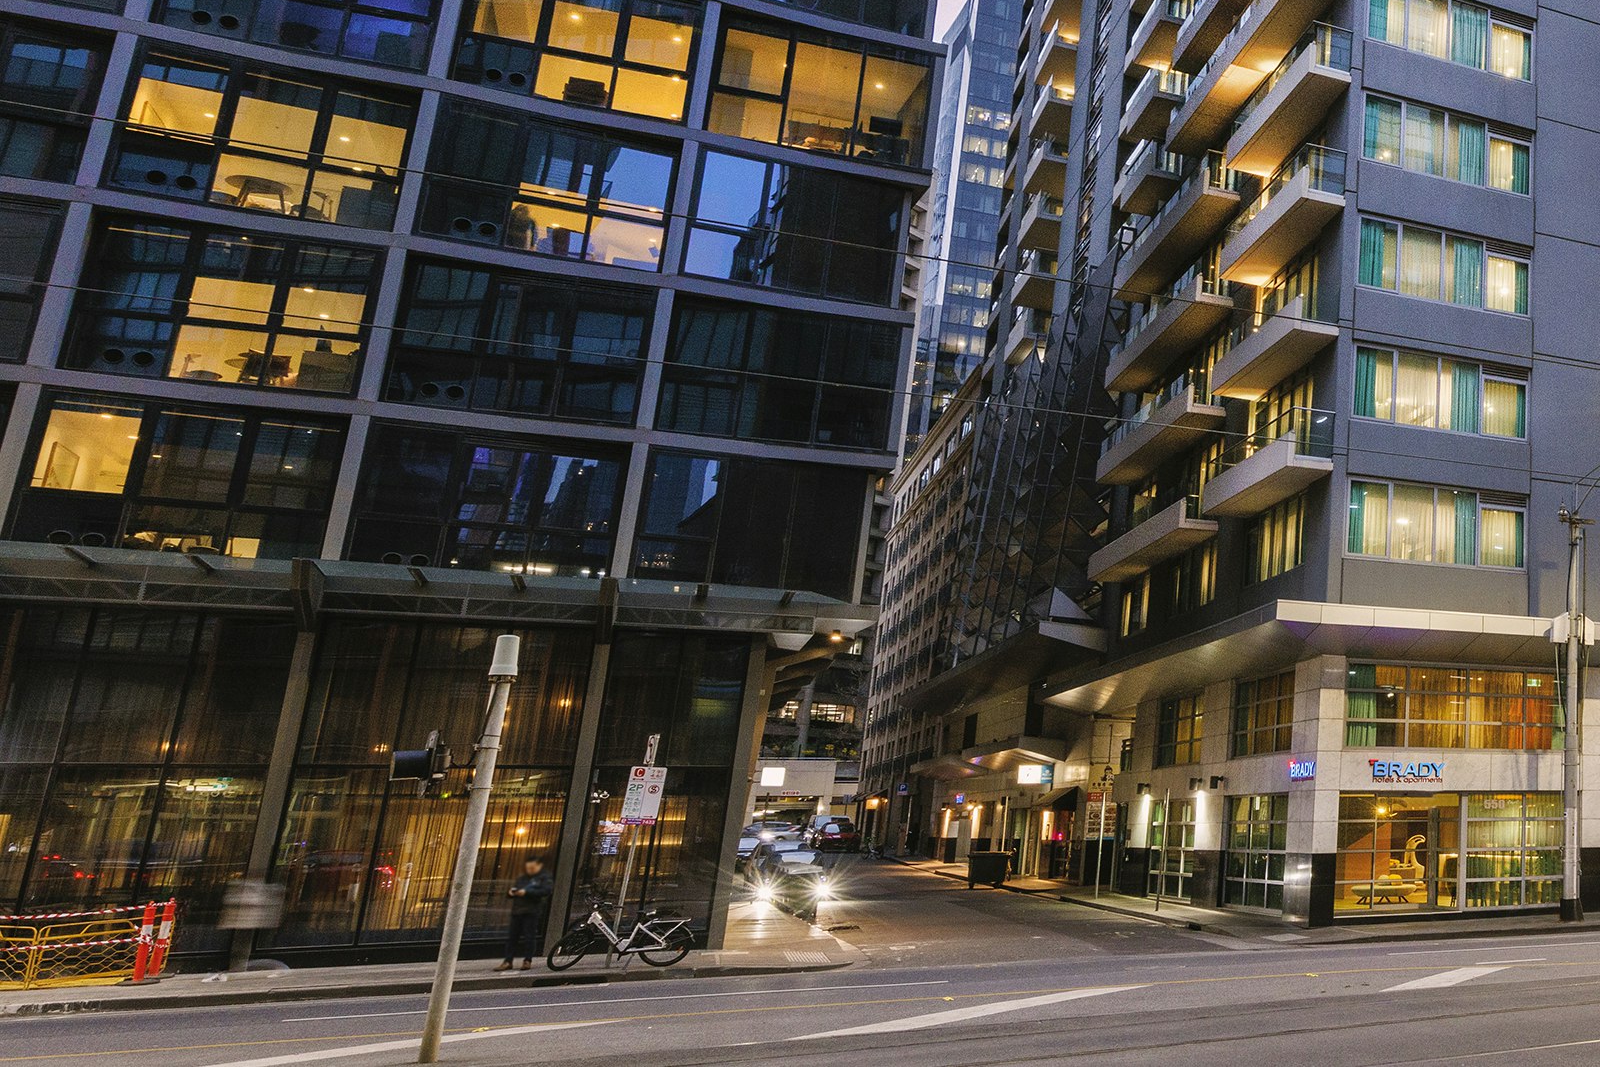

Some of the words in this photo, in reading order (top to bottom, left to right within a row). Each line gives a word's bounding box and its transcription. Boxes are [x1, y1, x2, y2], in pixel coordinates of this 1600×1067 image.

[1290, 762, 1316, 778] BRADY
[1373, 761, 1446, 777] BRADY
[1372, 776, 1395, 784] hotels
[629, 783, 644, 792] 2P
